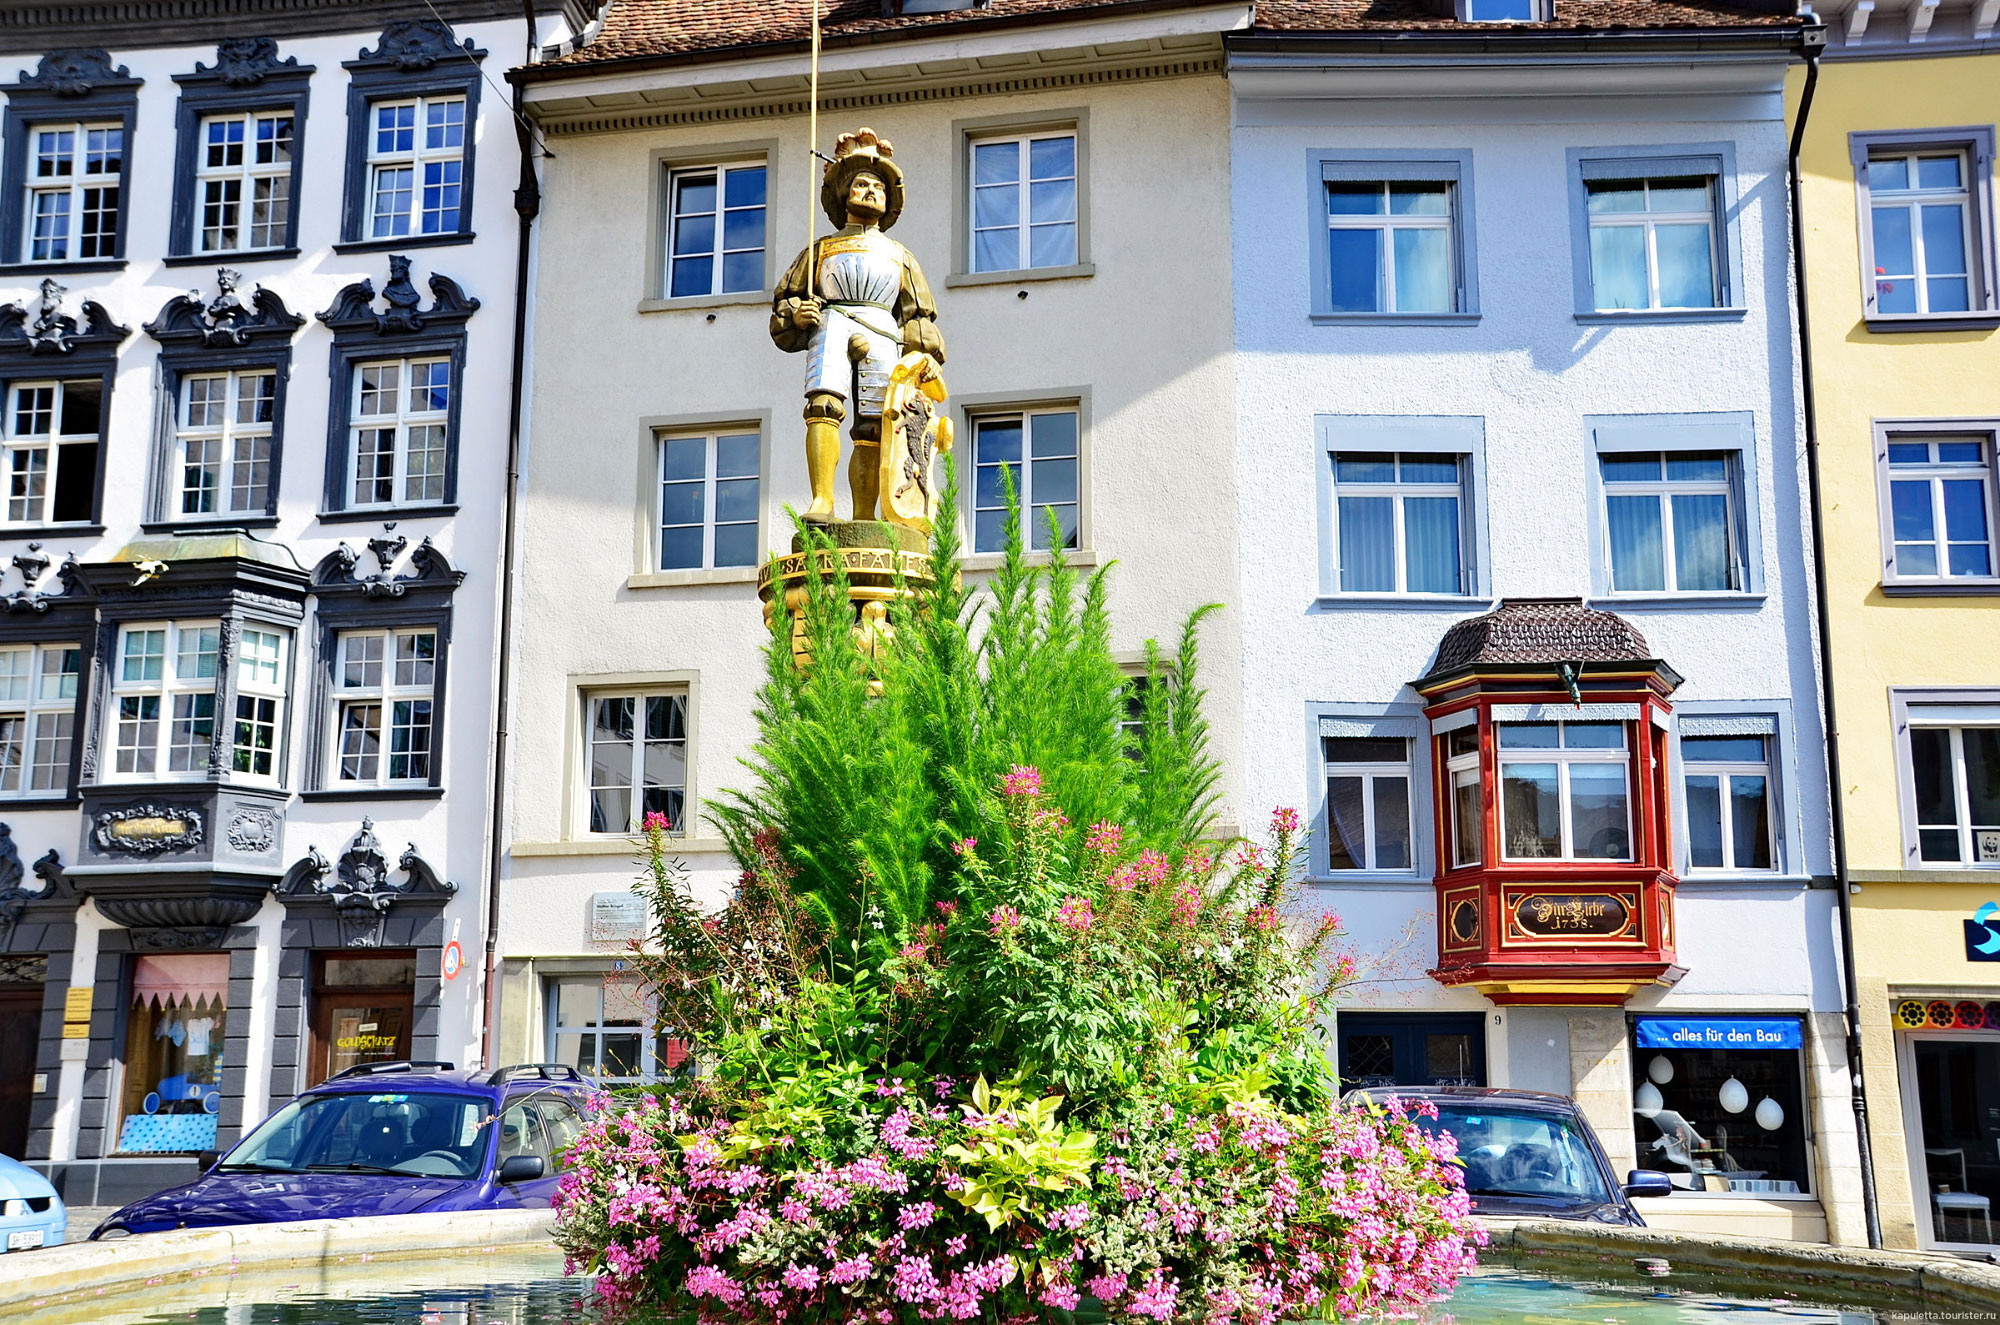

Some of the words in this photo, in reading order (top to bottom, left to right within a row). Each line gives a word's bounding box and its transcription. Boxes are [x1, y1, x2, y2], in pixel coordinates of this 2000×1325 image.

[786, 552, 851, 574] SARA
[1494, 1014, 1502, 1026] 9
[1672, 1028, 1703, 1042] alles
[1706, 1028, 1724, 1042] für
[1727, 1028, 1752, 1042] den
[1756, 1029, 1782, 1042] Bau
[336, 1035, 396, 1050] GOLDSCHATZ
